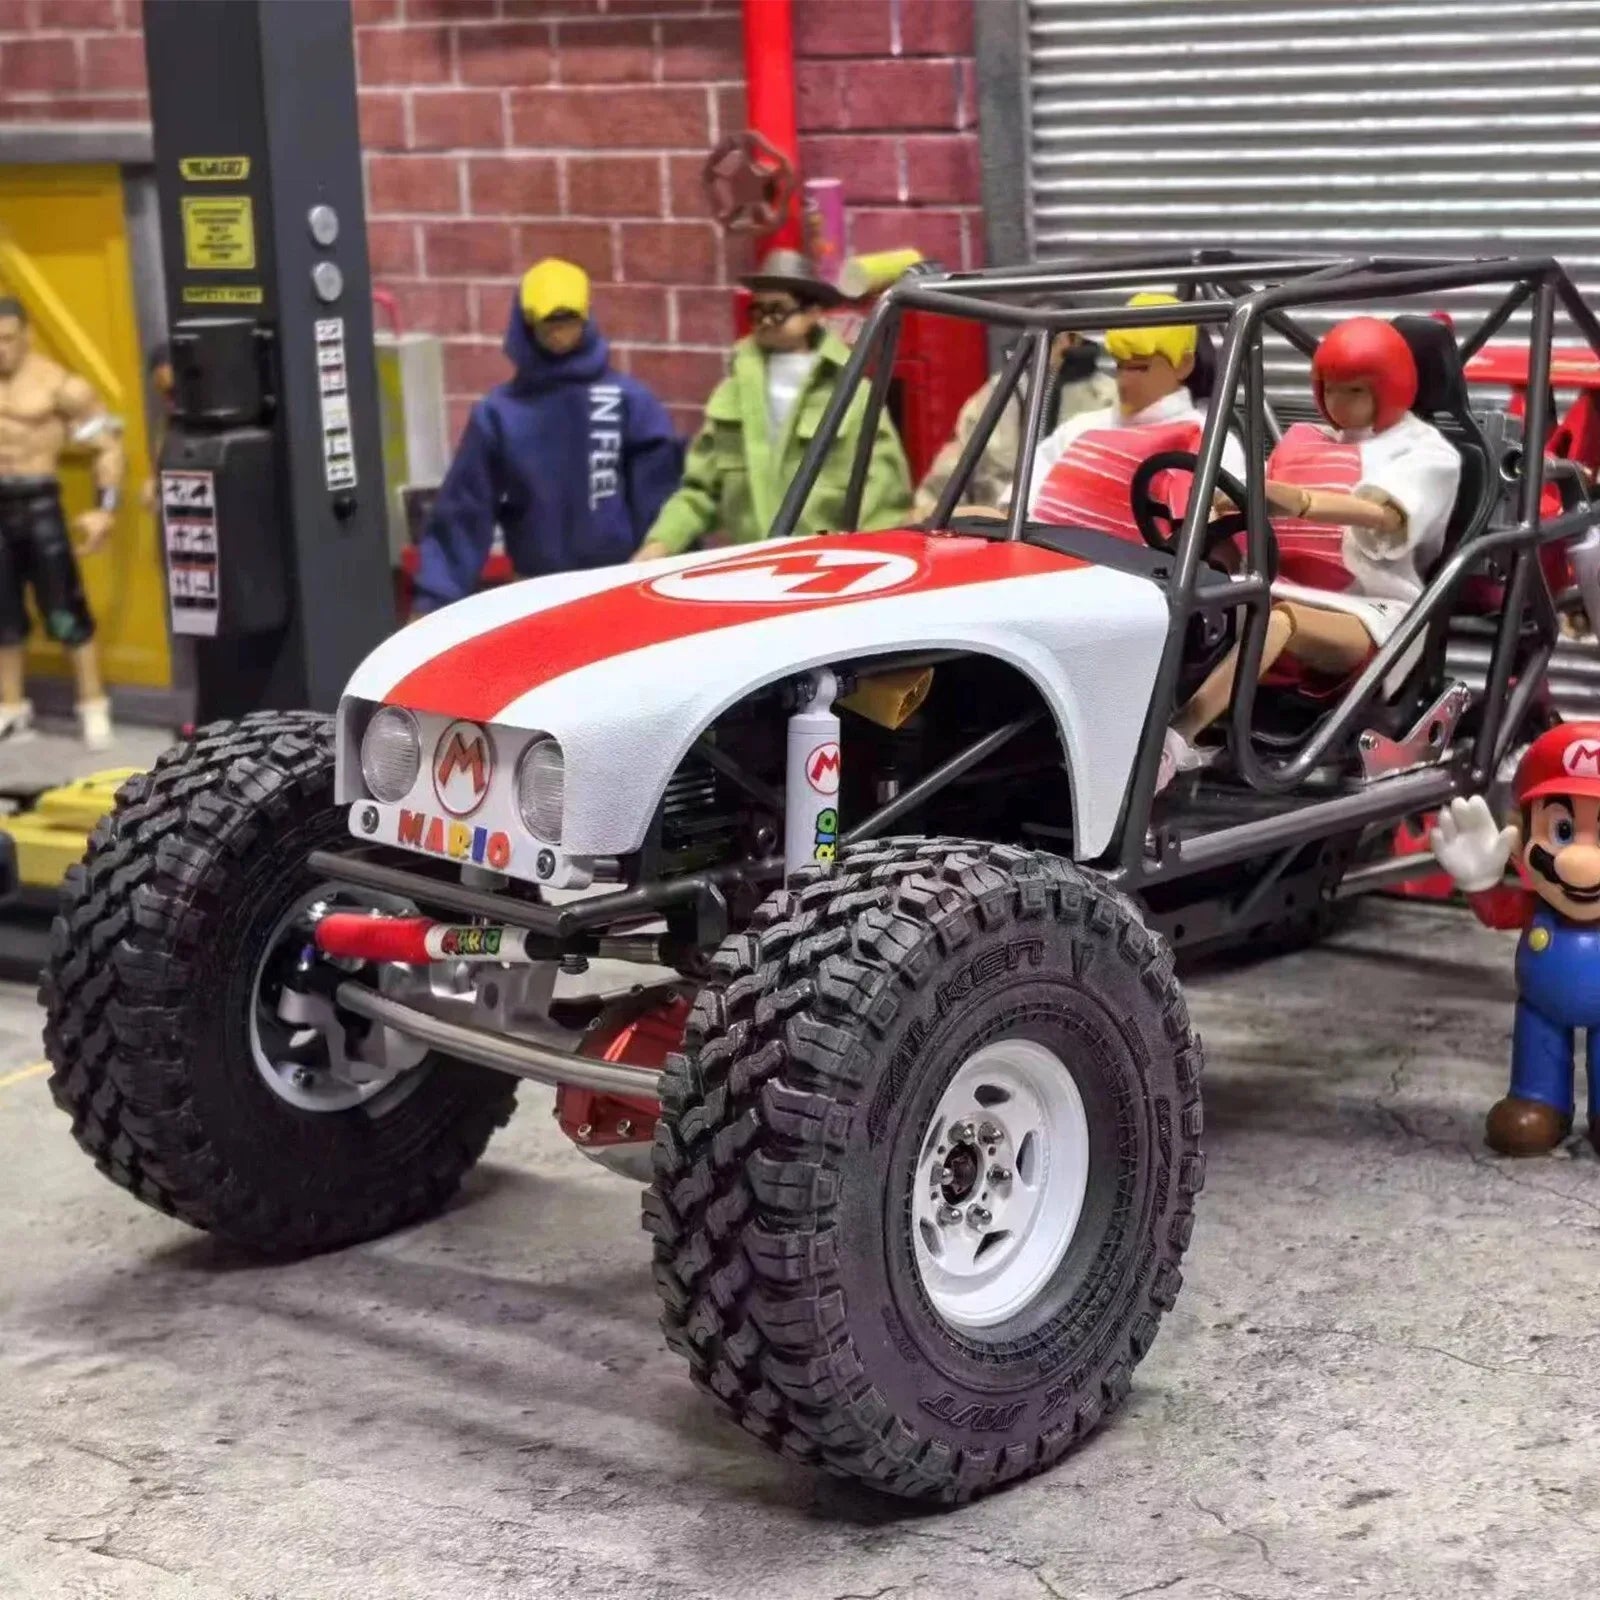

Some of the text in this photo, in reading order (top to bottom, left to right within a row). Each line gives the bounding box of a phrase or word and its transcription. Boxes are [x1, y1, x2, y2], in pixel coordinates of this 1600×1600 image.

[589, 385, 620, 511] IN FEEL
[681, 553, 893, 594] M
[438, 732, 486, 794] M
[811, 750, 840, 782] M
[1569, 743, 1600, 775] M
[398, 808, 511, 870] MARIO
[814, 807, 838, 866] RIO
[441, 926, 501, 955] MARIO
